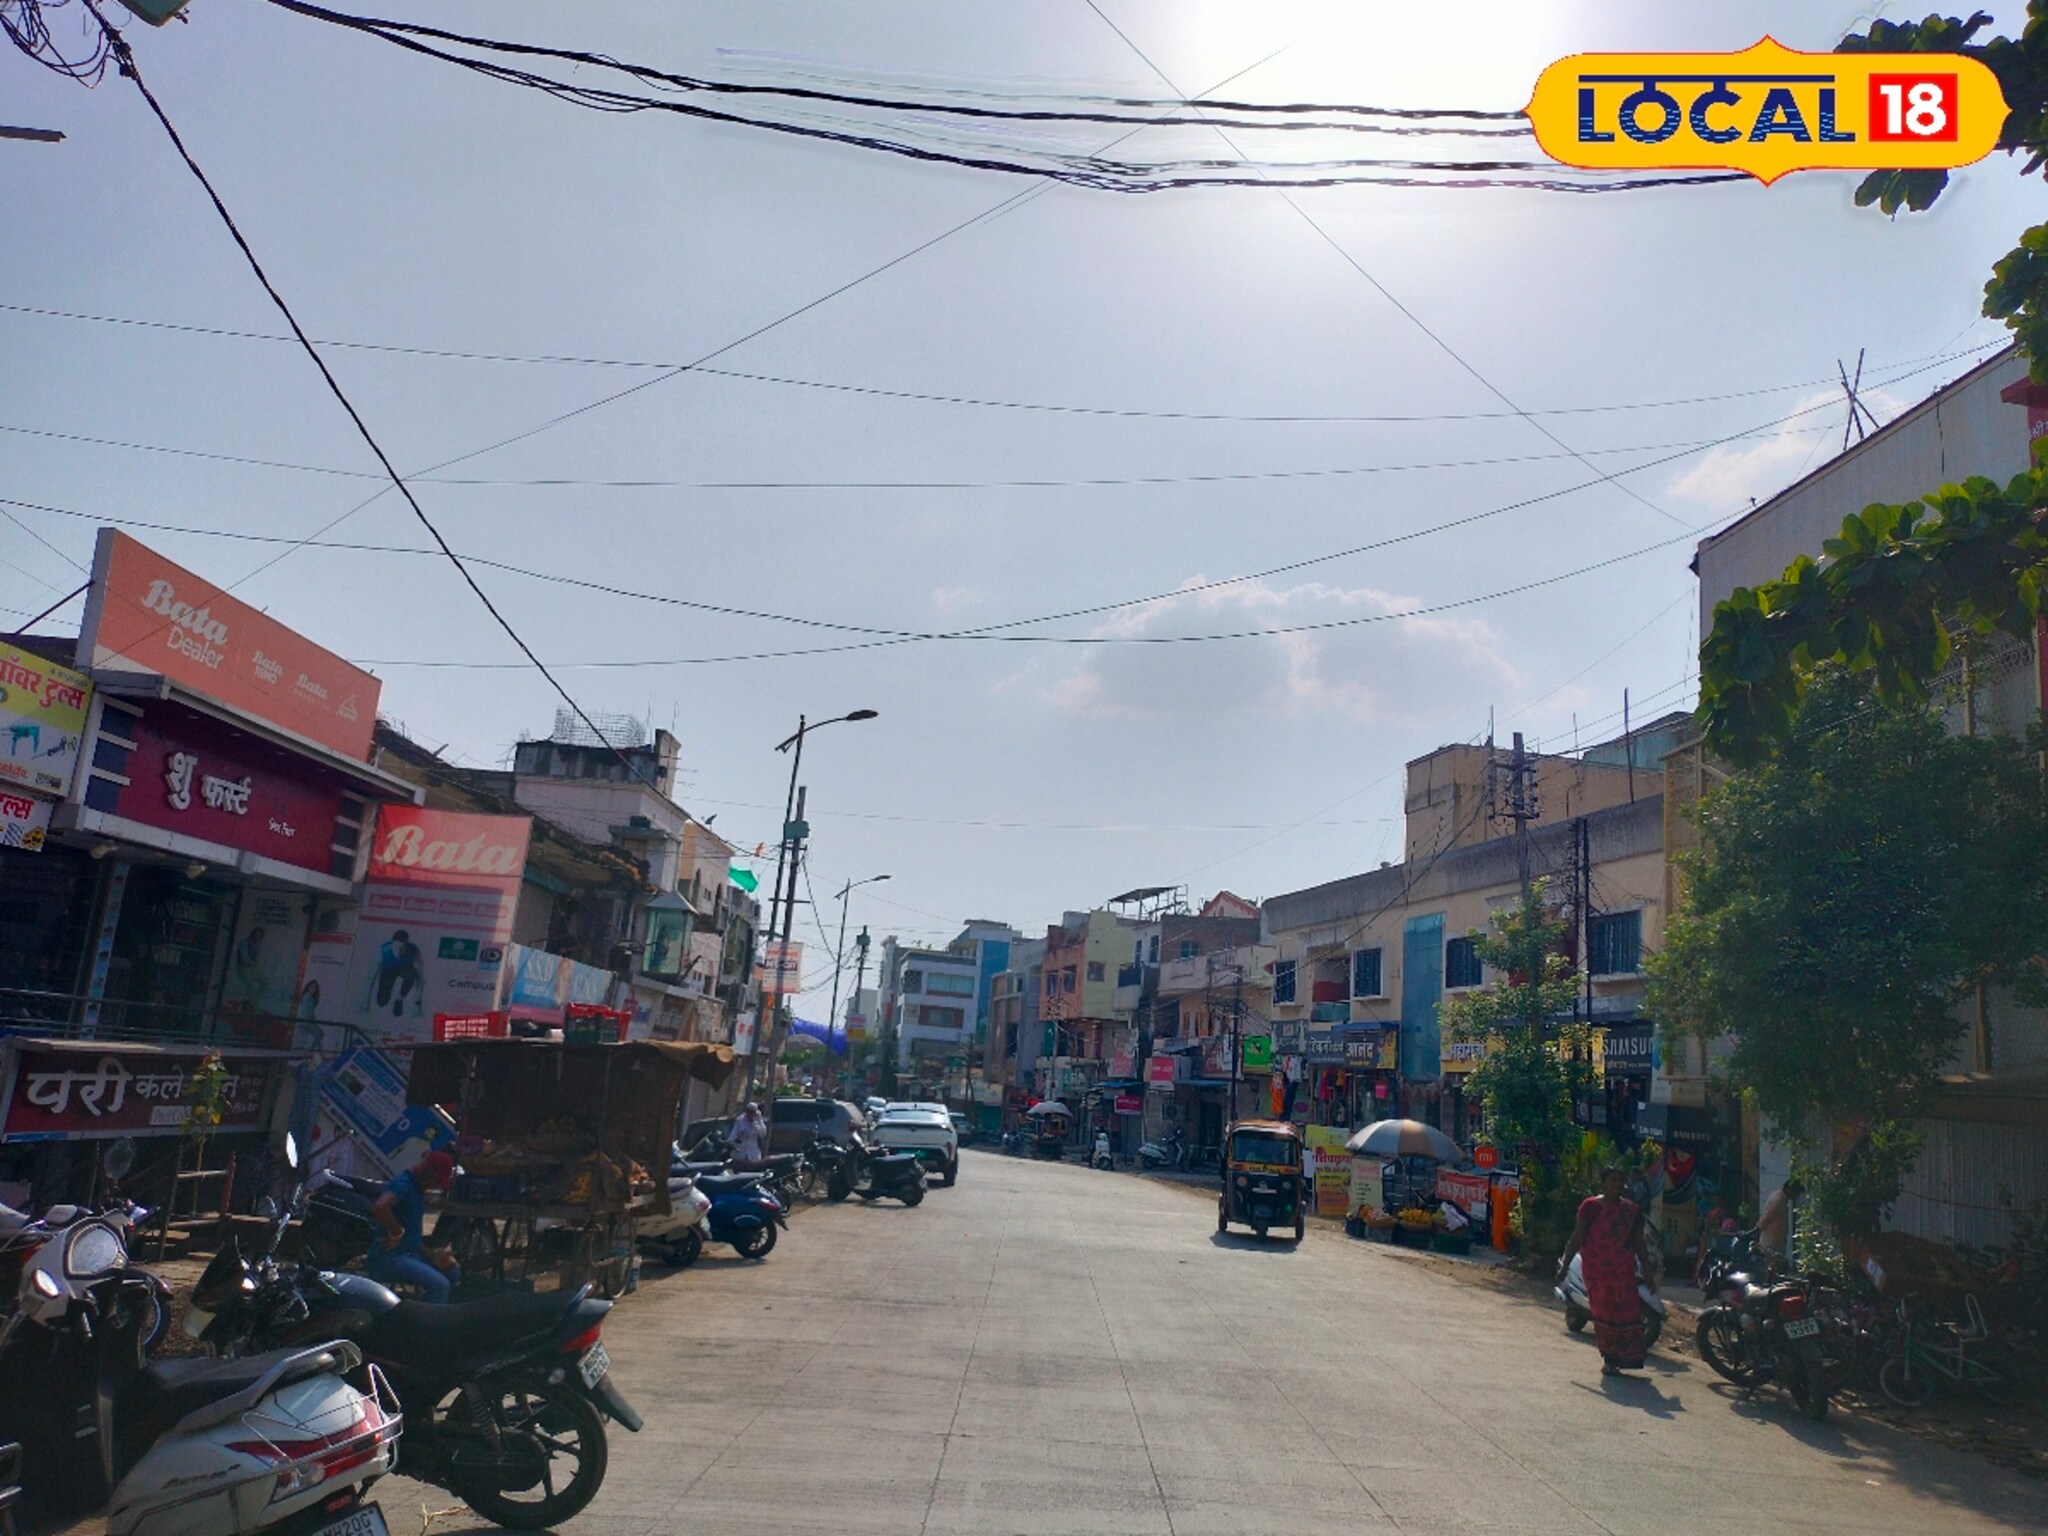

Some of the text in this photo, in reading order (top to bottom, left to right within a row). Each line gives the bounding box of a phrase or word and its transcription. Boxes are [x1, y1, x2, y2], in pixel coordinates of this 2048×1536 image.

[141, 579, 229, 646] Bata
[166, 627, 225, 670] Dealer
[374, 825, 520, 875] Bata
[1346, 1037, 1374, 1059] आनंद
[27, 1056, 135, 1117] परी
[1479, 1153, 1492, 1162] mi
